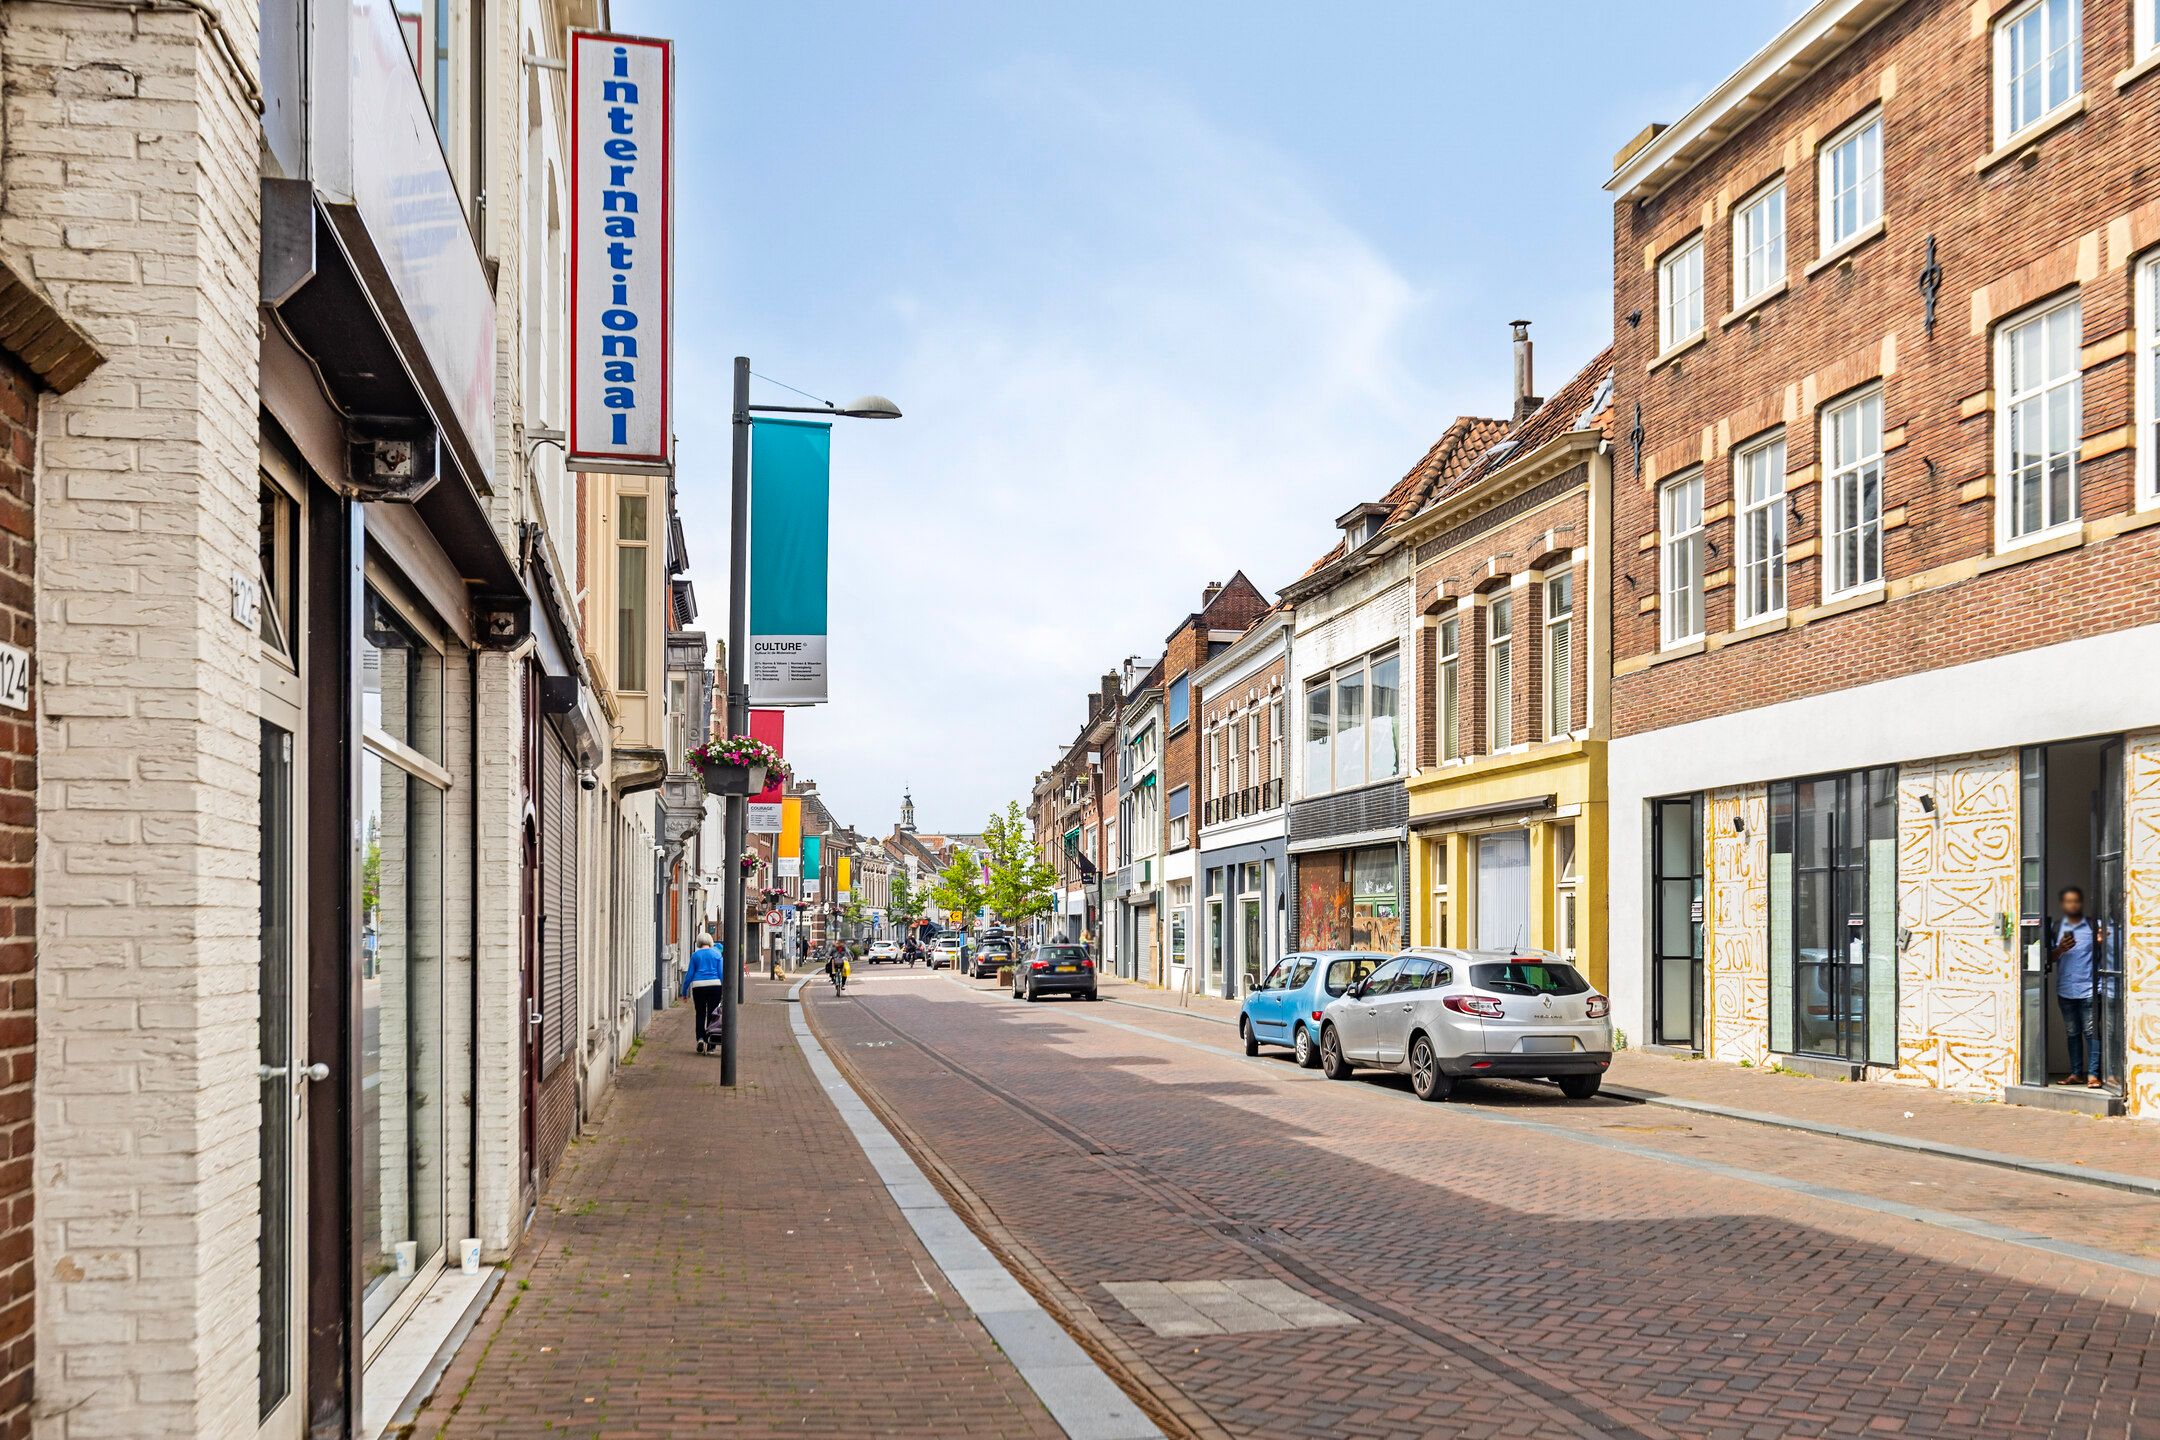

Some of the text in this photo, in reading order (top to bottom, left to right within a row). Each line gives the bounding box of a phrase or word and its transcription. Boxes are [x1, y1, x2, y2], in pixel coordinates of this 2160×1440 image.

[602, 47, 638, 445] internationaal
[755, 642, 802, 651] CULTURE
[0, 651, 27, 704] 124
